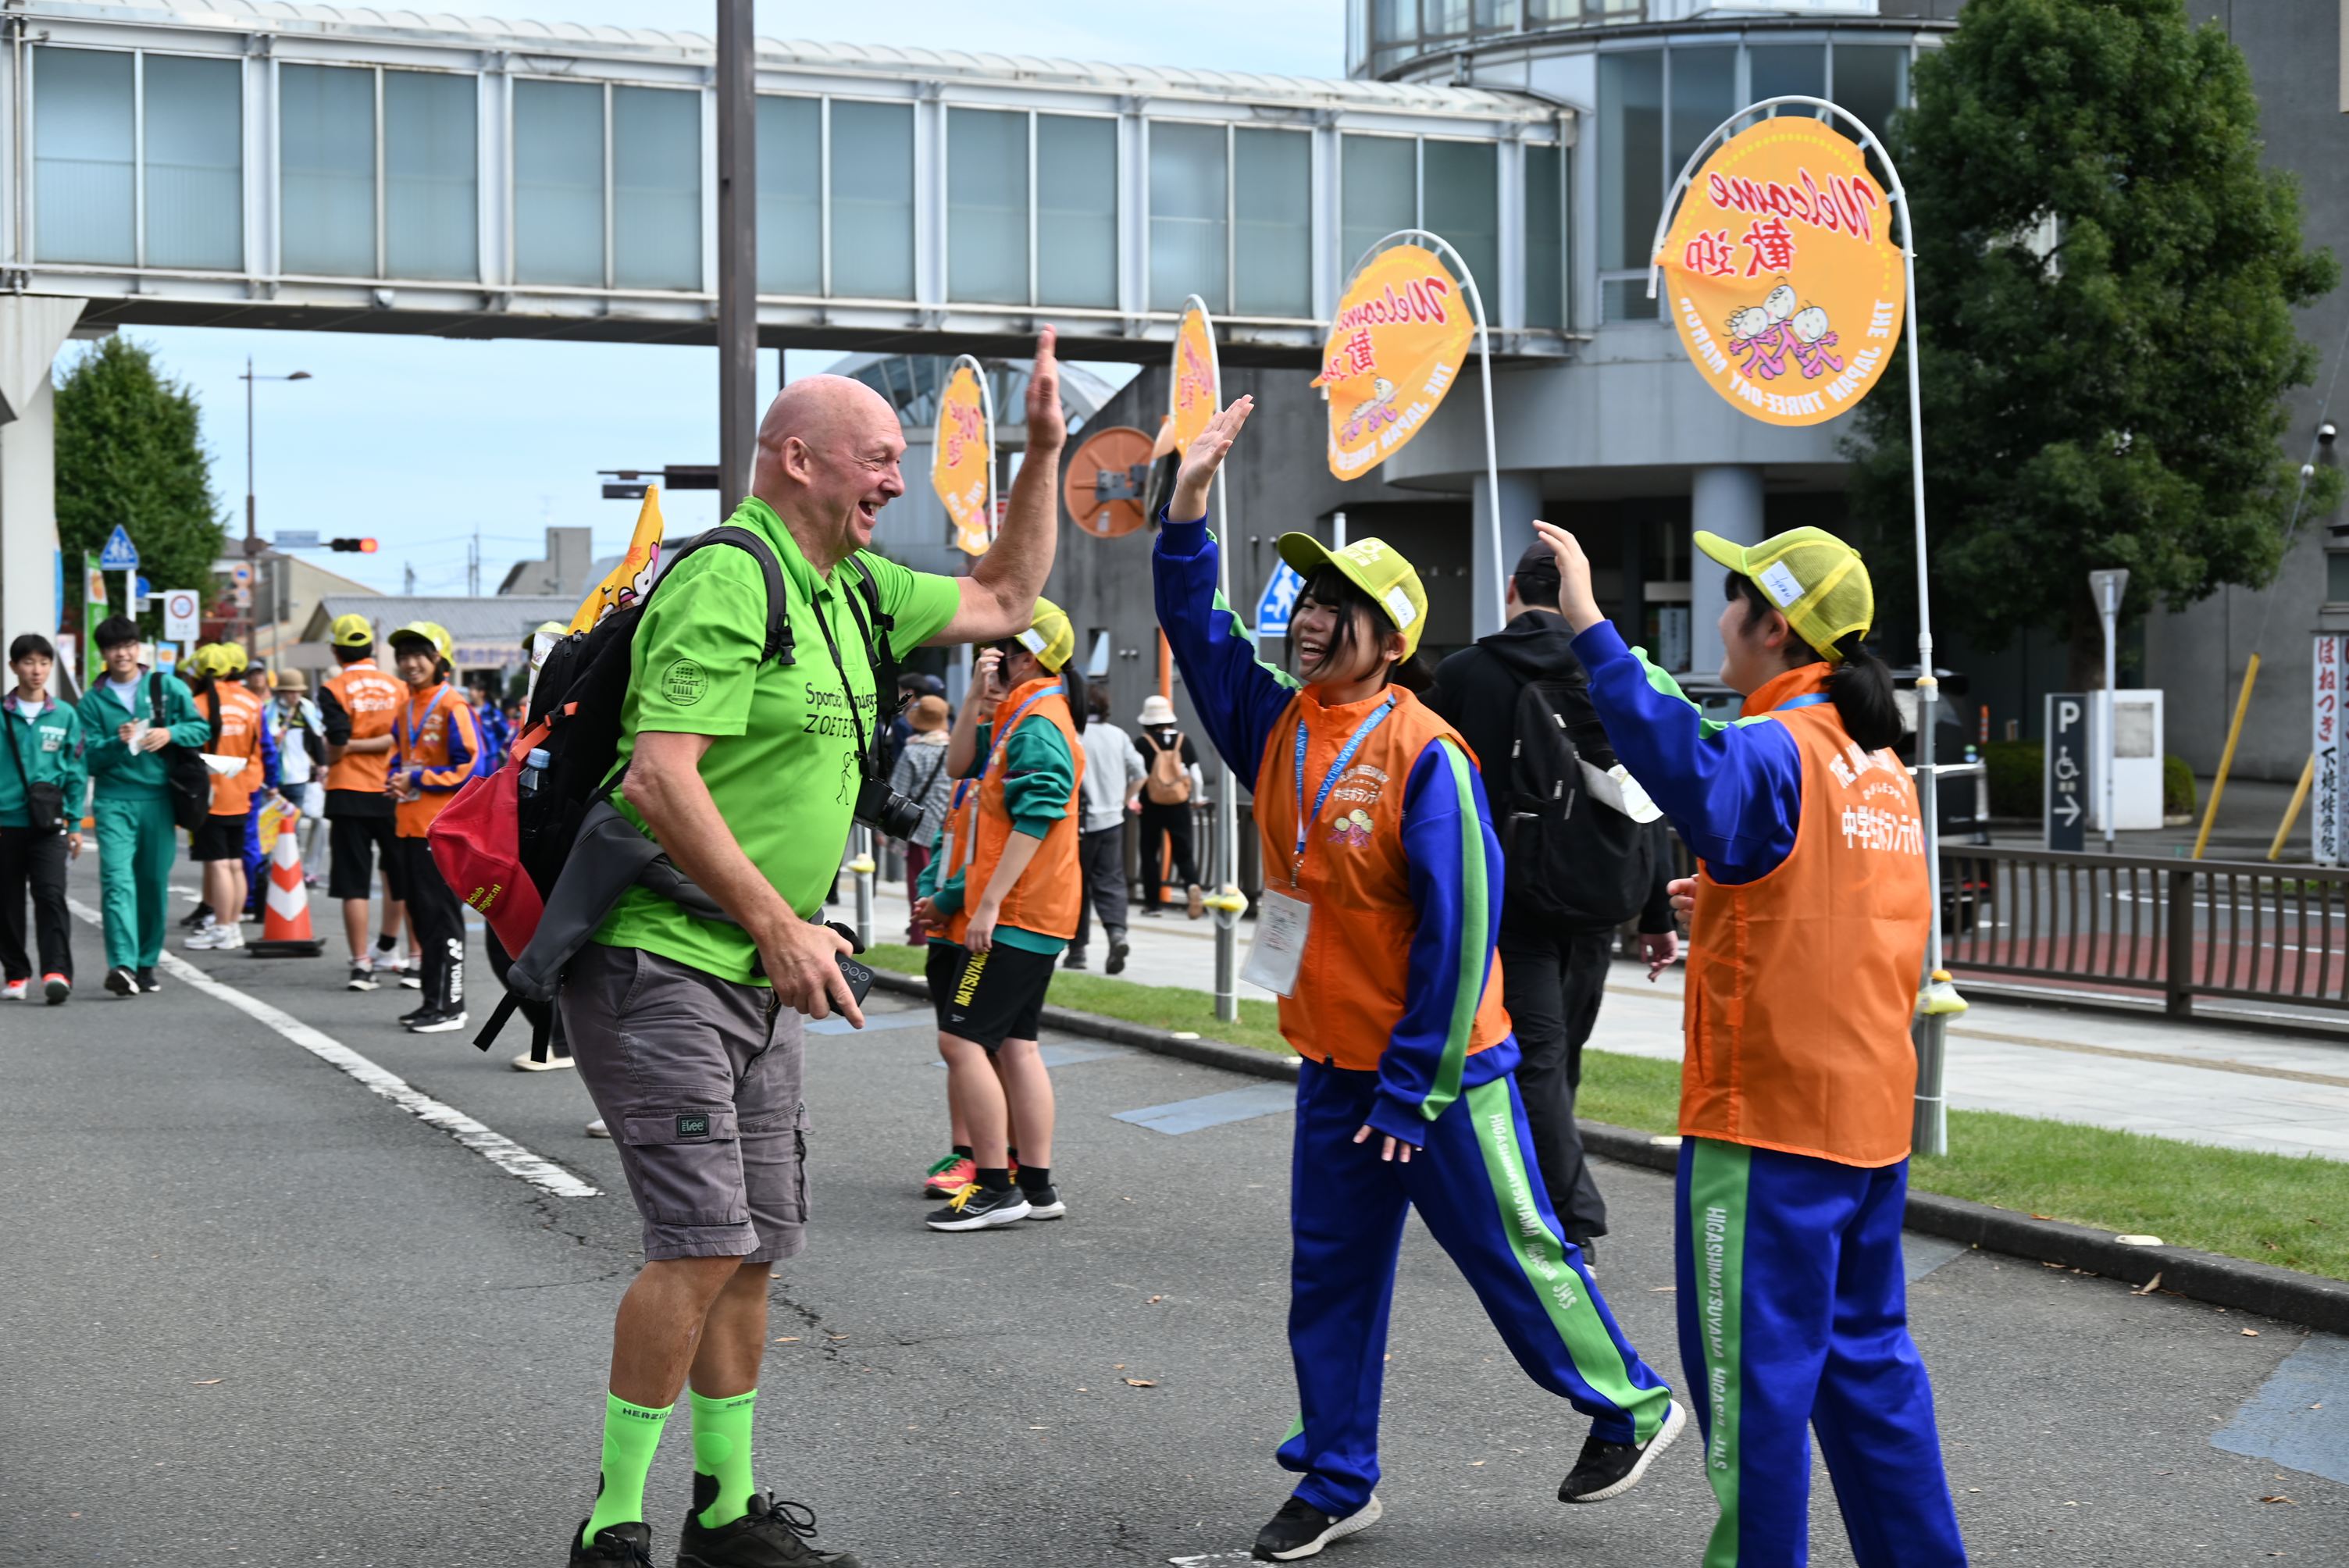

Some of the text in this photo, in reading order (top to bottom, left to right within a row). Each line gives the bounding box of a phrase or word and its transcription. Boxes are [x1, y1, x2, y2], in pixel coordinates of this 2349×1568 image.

[2058, 701, 2080, 733] P
[2318, 636, 2336, 742] ほねつぎ
[954, 949, 990, 1007] MATSUYAM
[1705, 1206, 1727, 1359] HIGASHIMATSUYAMA
